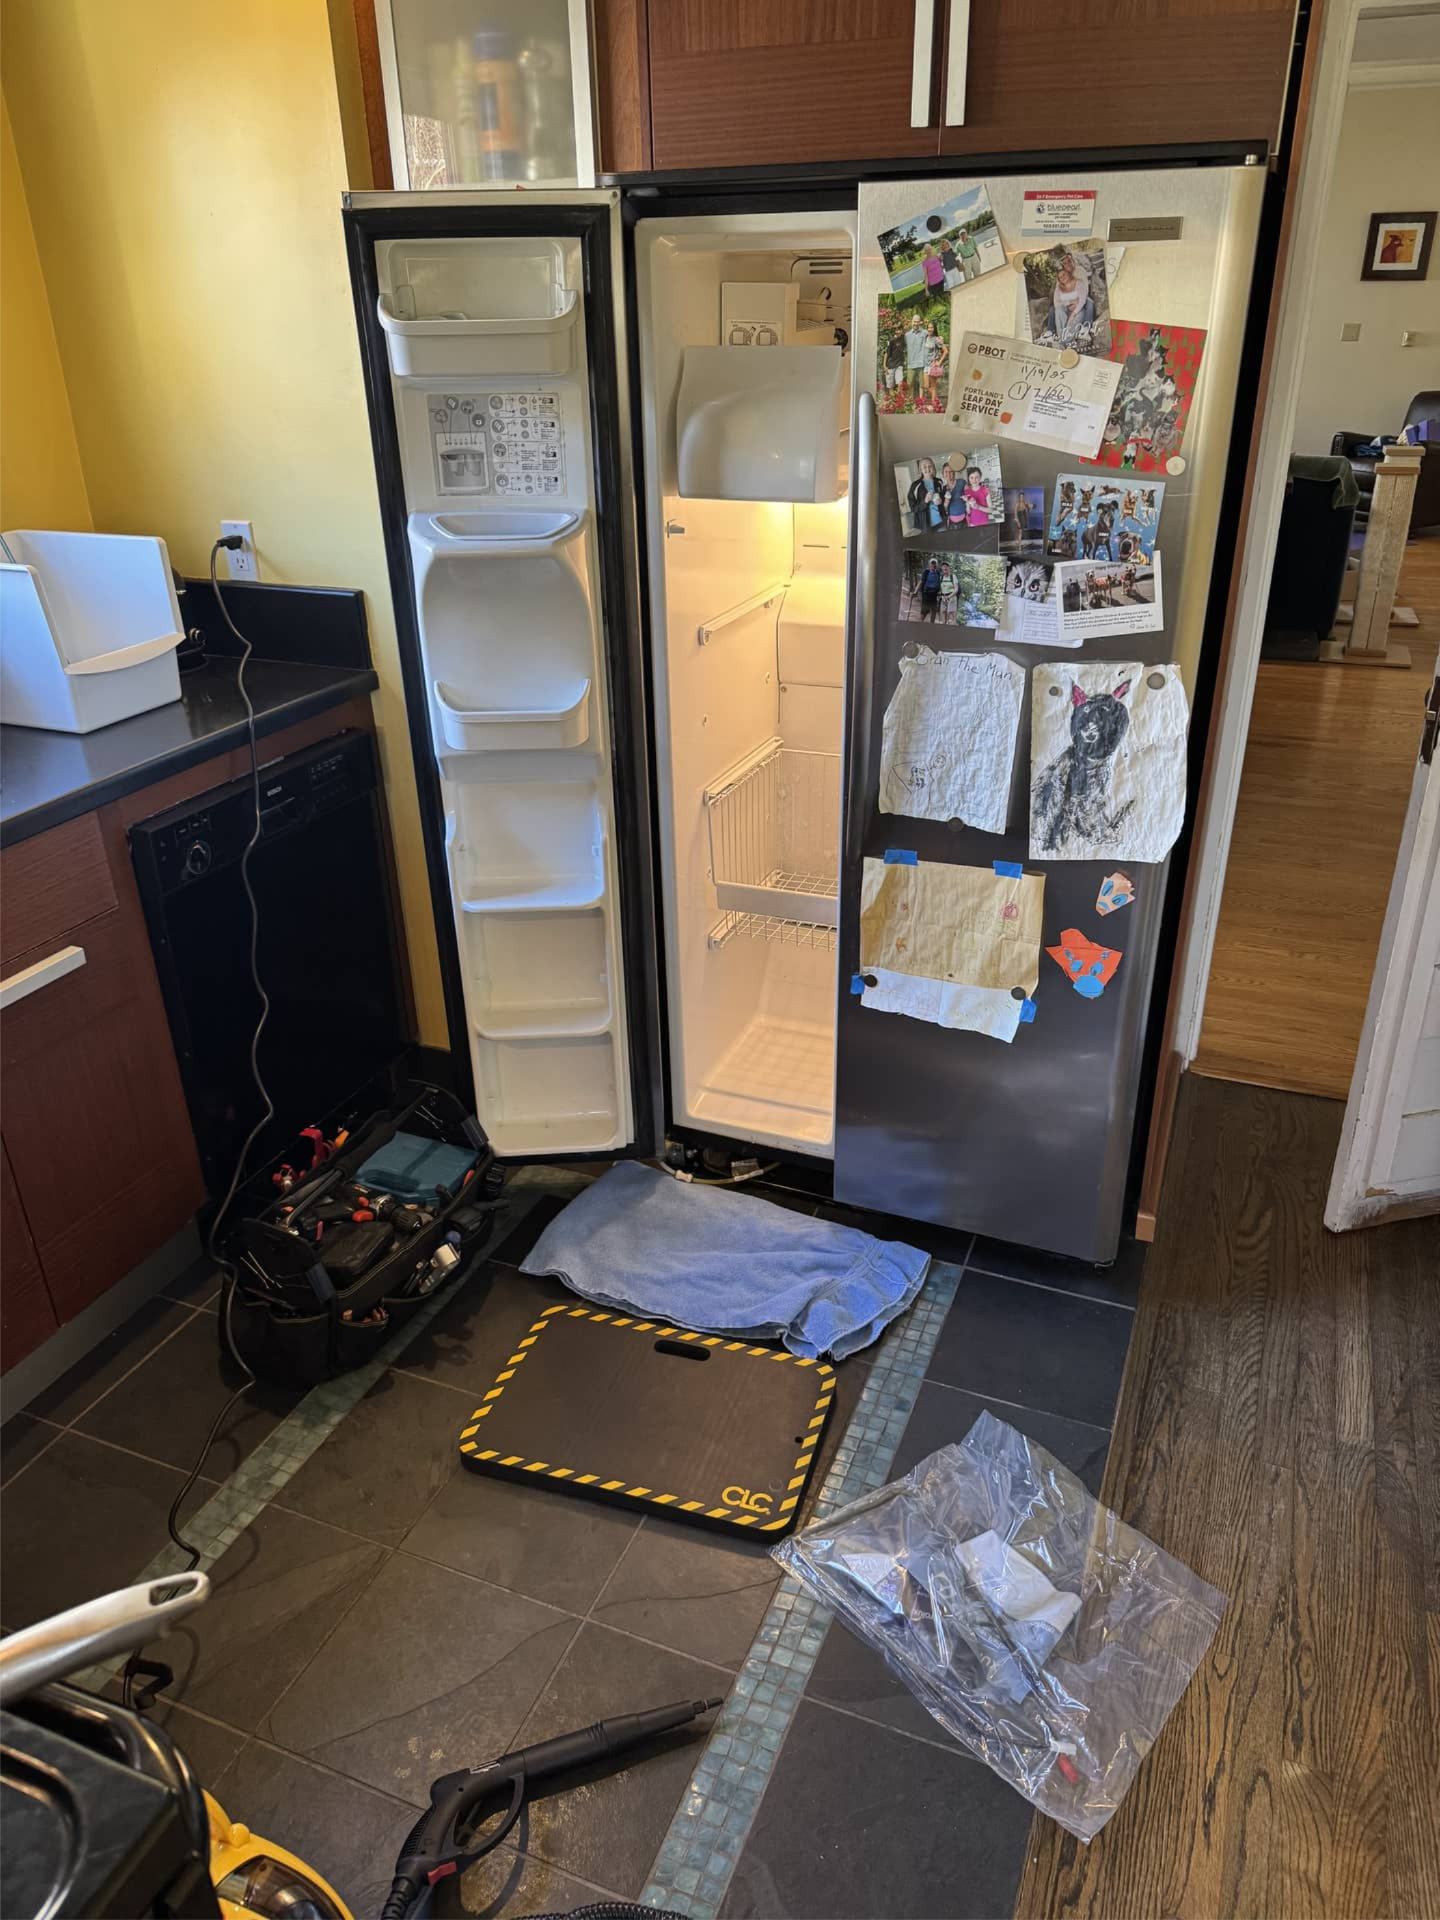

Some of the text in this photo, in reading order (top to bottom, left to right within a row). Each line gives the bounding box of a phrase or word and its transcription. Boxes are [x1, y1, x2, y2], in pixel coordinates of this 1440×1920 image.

[978, 345, 1006, 359] PBOT
[964, 387, 1004, 399] PORTLAND'S
[963, 394, 1003, 408] LEAF DAY
[960, 401, 1000, 417] SERVICE
[721, 1485, 773, 1514] CLC
